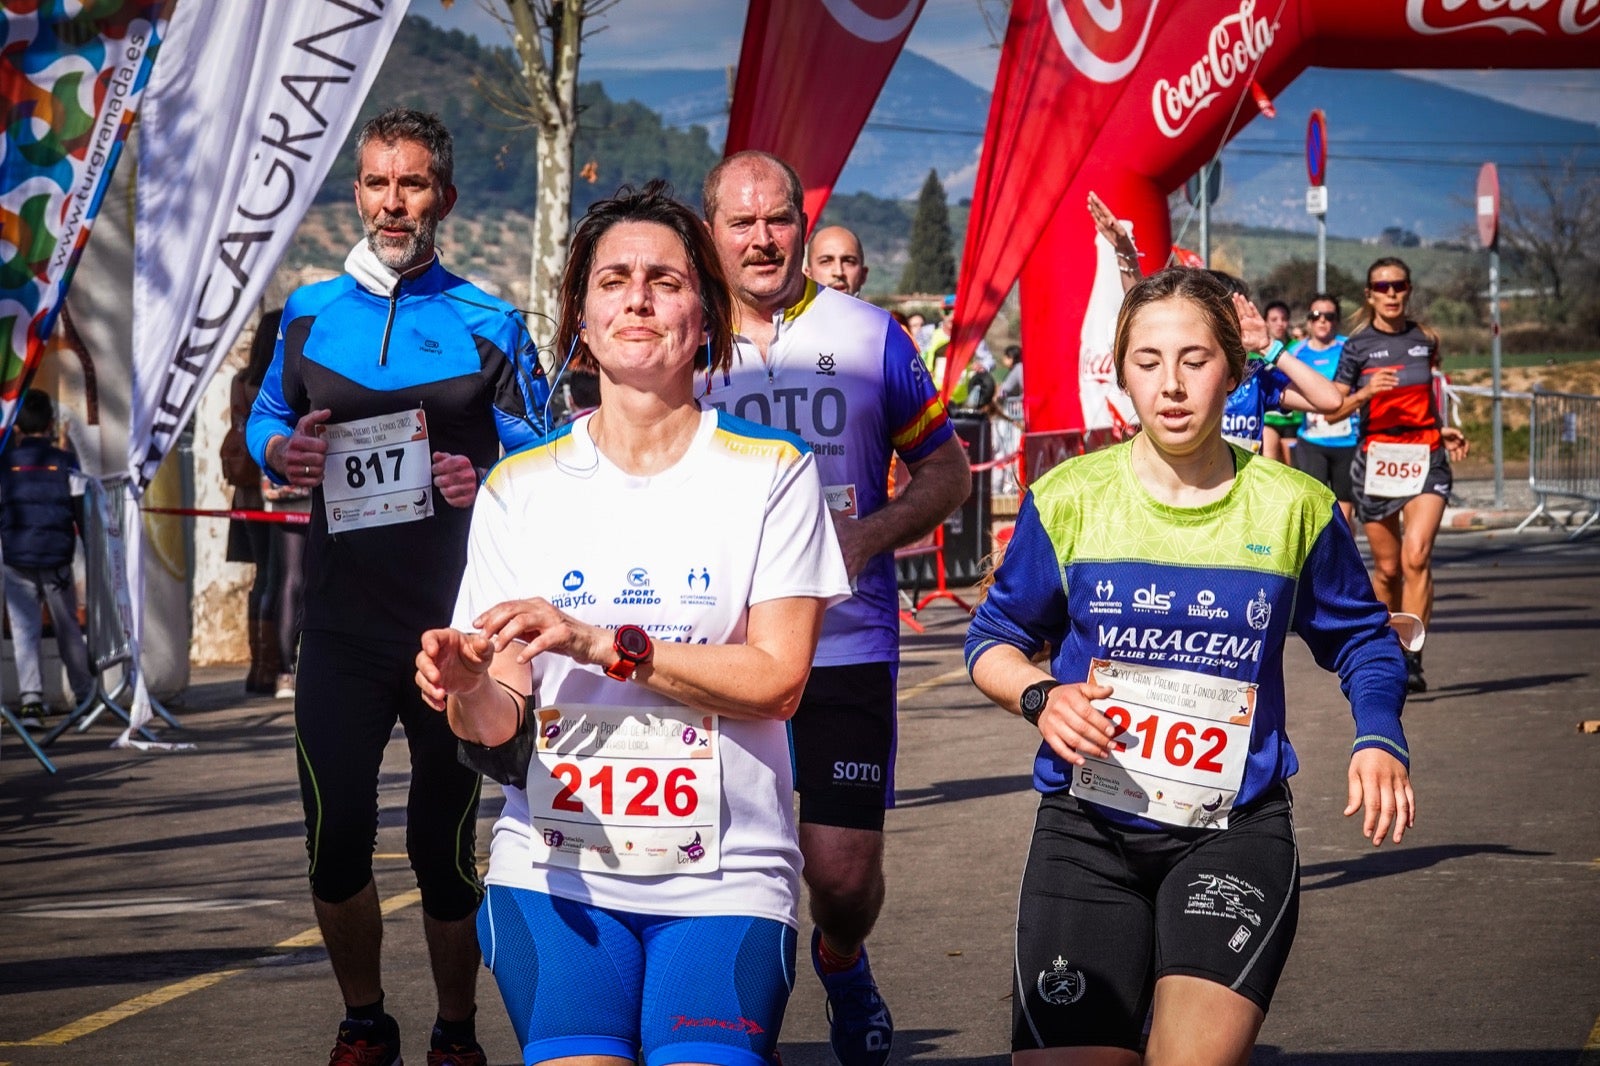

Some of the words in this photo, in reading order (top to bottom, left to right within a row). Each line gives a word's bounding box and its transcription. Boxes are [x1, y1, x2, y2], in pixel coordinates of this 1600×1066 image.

[1152, 0, 1280, 138] Coca-Cola
[54, 33, 146, 268] www.turgranada.es
[397, 417, 412, 429] 2022
[709, 388, 847, 437] OTO
[345, 448, 405, 489] 817
[1375, 461, 1422, 479] 2059
[552, 592, 597, 609] mayfo
[613, 597, 662, 605] GARRIDO
[621, 589, 655, 597] SPORT
[1188, 607, 1229, 620] mayfo
[1098, 624, 1262, 662] MARACENA
[1110, 649, 1146, 661] CLUB
[1150, 652, 1166, 661] DE
[1168, 654, 1238, 669] ATLETISMO
[1132, 671, 1151, 686] GRAN
[1154, 675, 1180, 692] PREMIO
[1193, 683, 1217, 700] FONDO
[1217, 688, 1239, 704] 2022
[1103, 705, 1229, 774] 2162
[833, 761, 881, 782] SOTO
[551, 763, 699, 818] 2126
